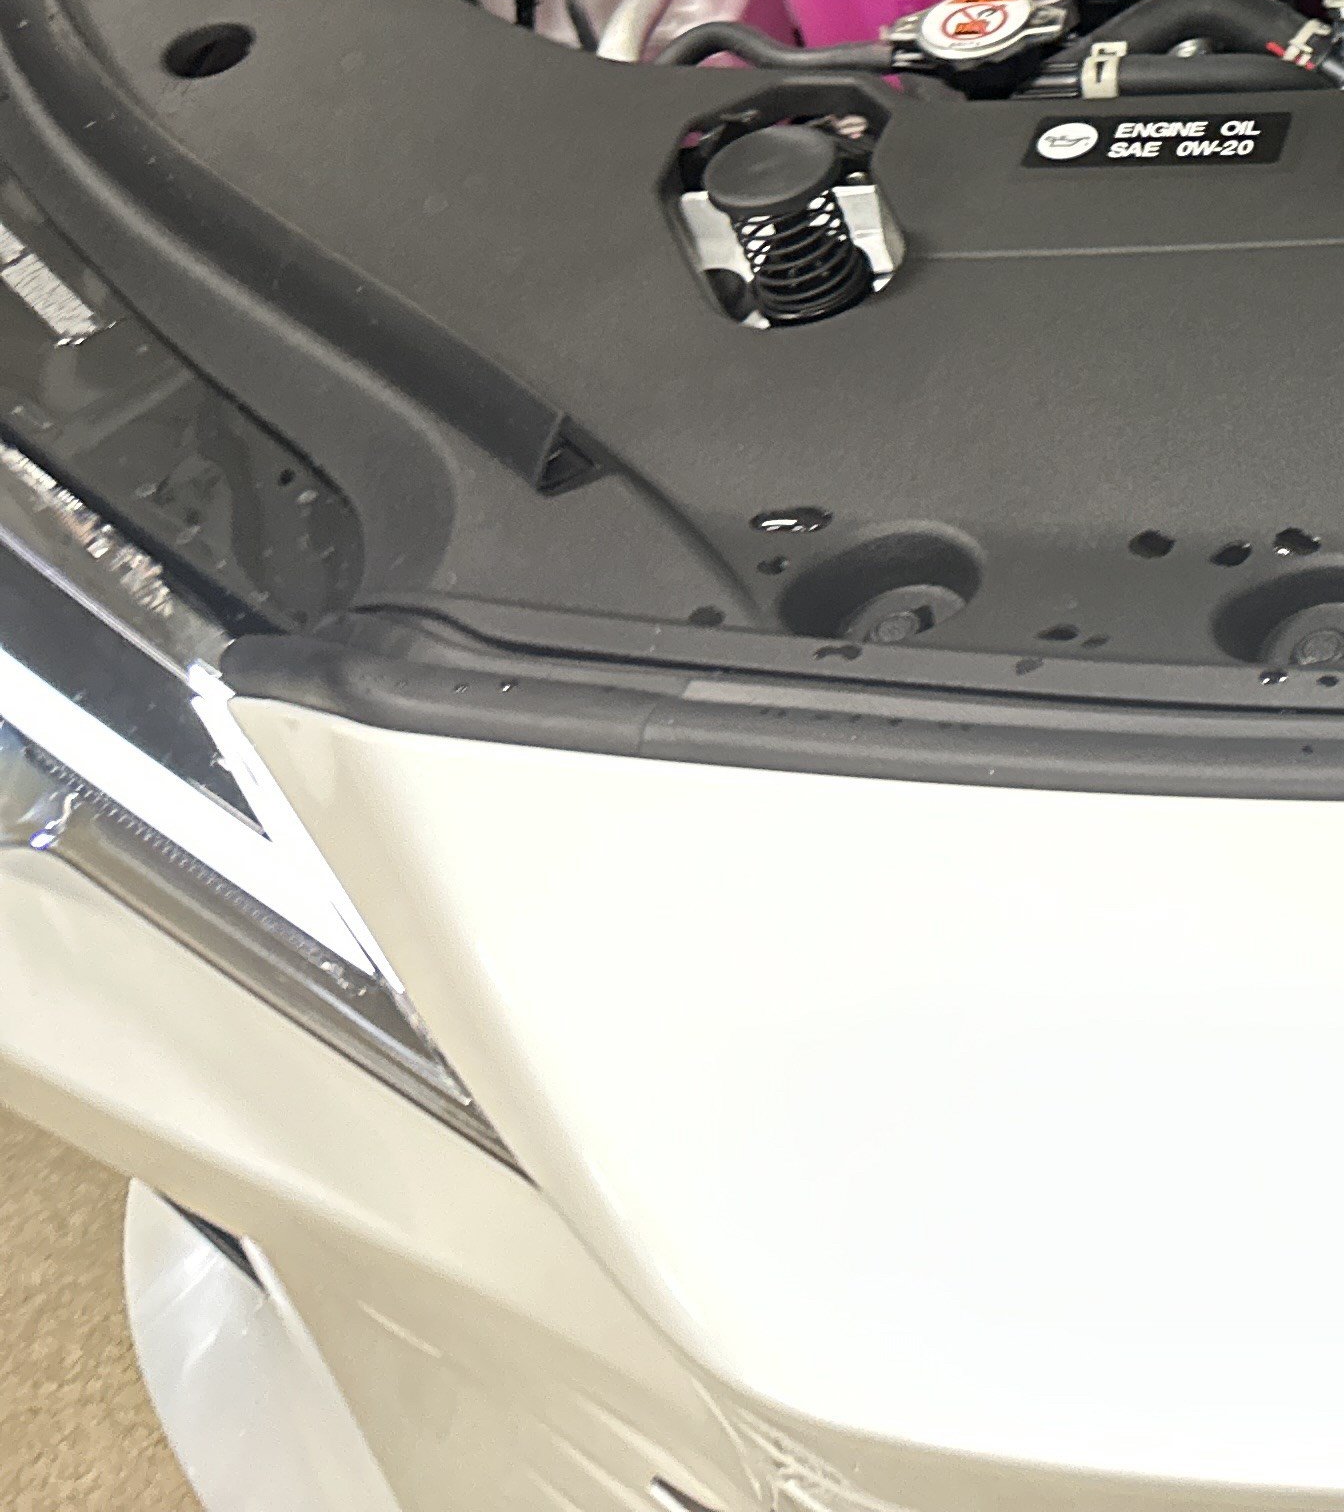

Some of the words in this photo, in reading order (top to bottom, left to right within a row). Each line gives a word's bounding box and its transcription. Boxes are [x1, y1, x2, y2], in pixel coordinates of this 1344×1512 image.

[1114, 121, 1208, 138] ENGINE
[1220, 120, 1261, 136] OIL
[1107, 141, 1162, 158] SAE
[1176, 140, 1255, 157] 0W-20
